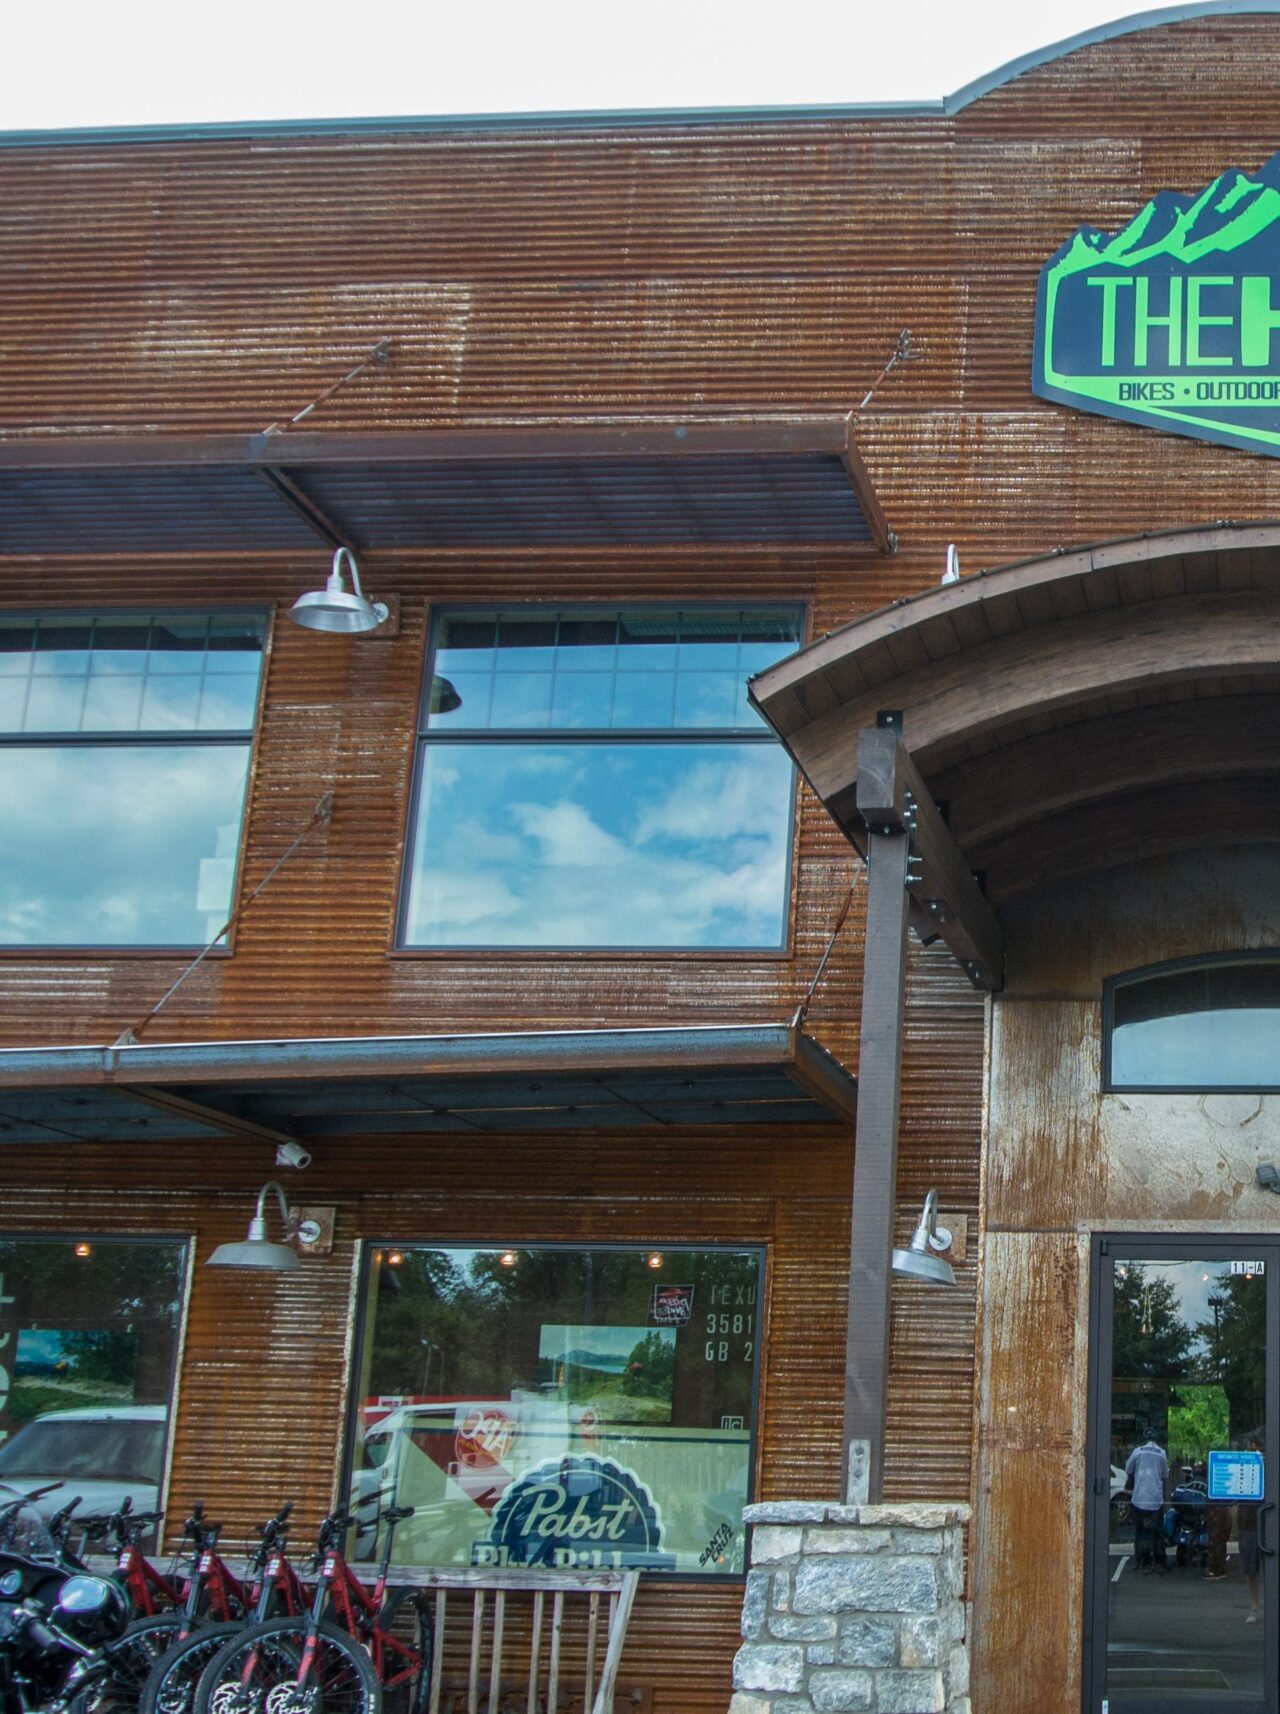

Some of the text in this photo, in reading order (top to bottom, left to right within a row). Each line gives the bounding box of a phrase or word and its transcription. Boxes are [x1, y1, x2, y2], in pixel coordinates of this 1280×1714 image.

[1119, 382, 1176, 401] BIKES
[1233, 1262, 1263, 1273] 11-A
[519, 1482, 634, 1540] Pabst
[699, 1522, 728, 1567] SANTA
[711, 1527, 735, 1564] CRUZ
